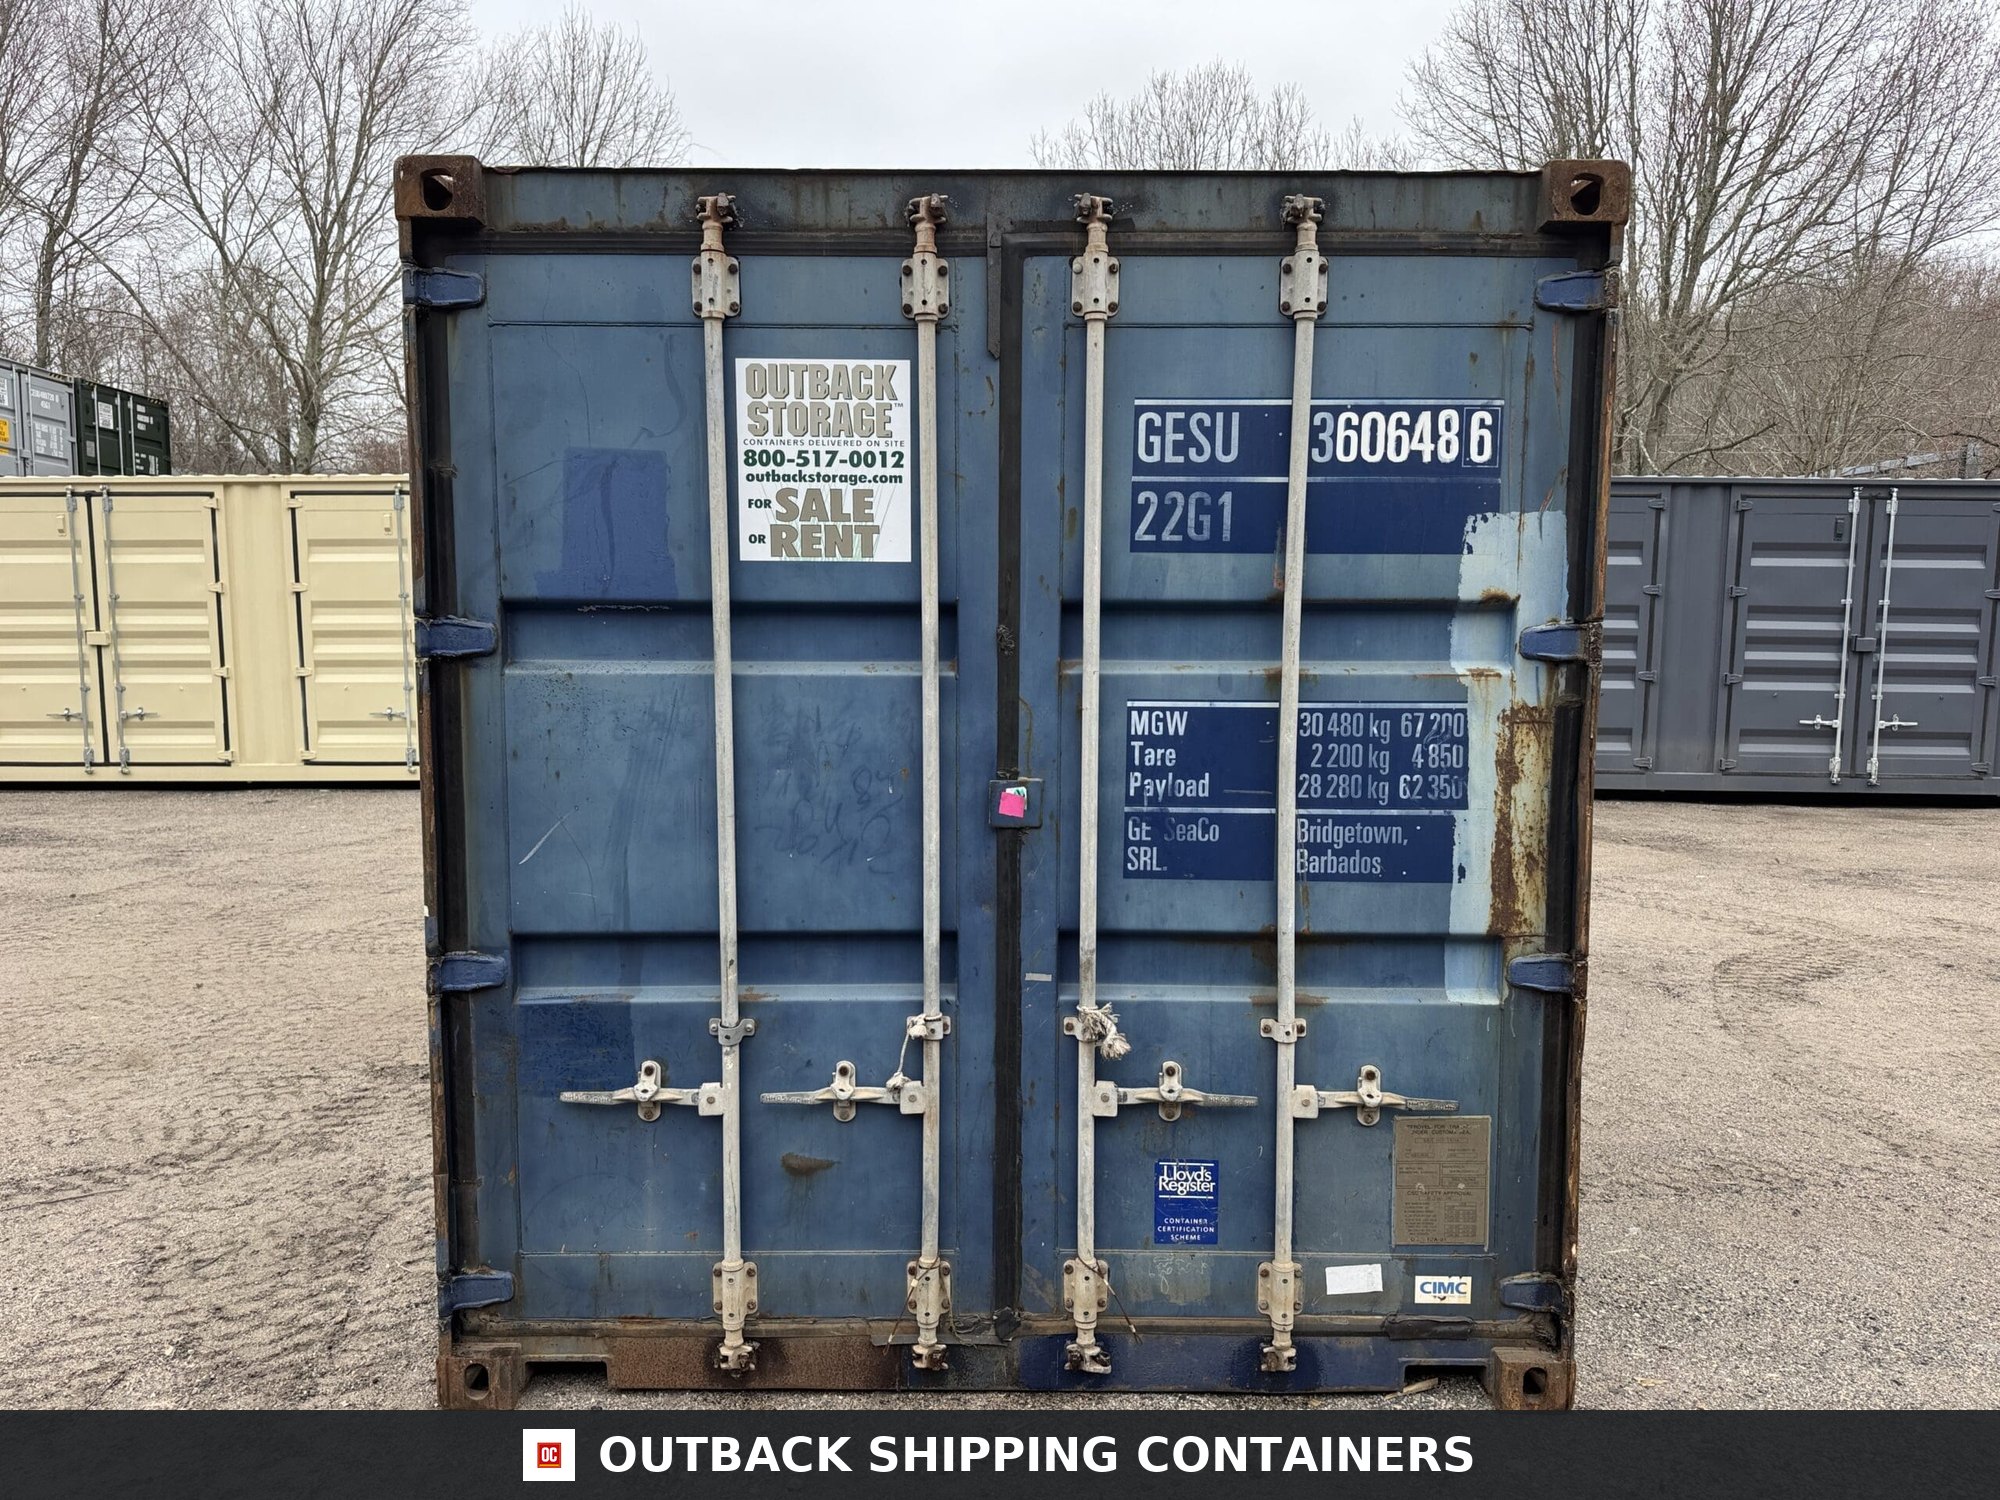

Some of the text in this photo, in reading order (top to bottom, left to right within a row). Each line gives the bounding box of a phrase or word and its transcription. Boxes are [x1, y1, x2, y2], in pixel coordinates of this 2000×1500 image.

[745, 363, 898, 400] OUTBACK
[747, 401, 892, 438] STORAGE
[743, 438, 805, 446] CONTAINERS
[1137, 411, 1240, 463] GESU
[743, 449, 904, 468] 800-517-0012
[745, 470, 903, 486] outbackstorage.com
[747, 487, 874, 523] FOR SALE
[1134, 490, 1233, 542] 22G1
[748, 524, 880, 558] OR RENT
[1130, 710, 1188, 736] MGW
[1369, 713, 1391, 745] kg
[1130, 741, 1177, 767] Tare
[1368, 743, 1390, 775] kg
[1129, 771, 1209, 803] Payload
[1367, 774, 1389, 806] kg
[1128, 816, 1220, 842] GE SeaCo
[1296, 818, 1408, 849] Bridgetown,
[1127, 846, 1168, 871] SRL.
[1296, 849, 1381, 874] Barbados
[1158, 1175, 1216, 1195] Register
[1163, 1165, 1212, 1184] Lloyd's
[1157, 1225, 1215, 1233] CERTIFICATION
[1419, 1281, 1467, 1295] CIMC
